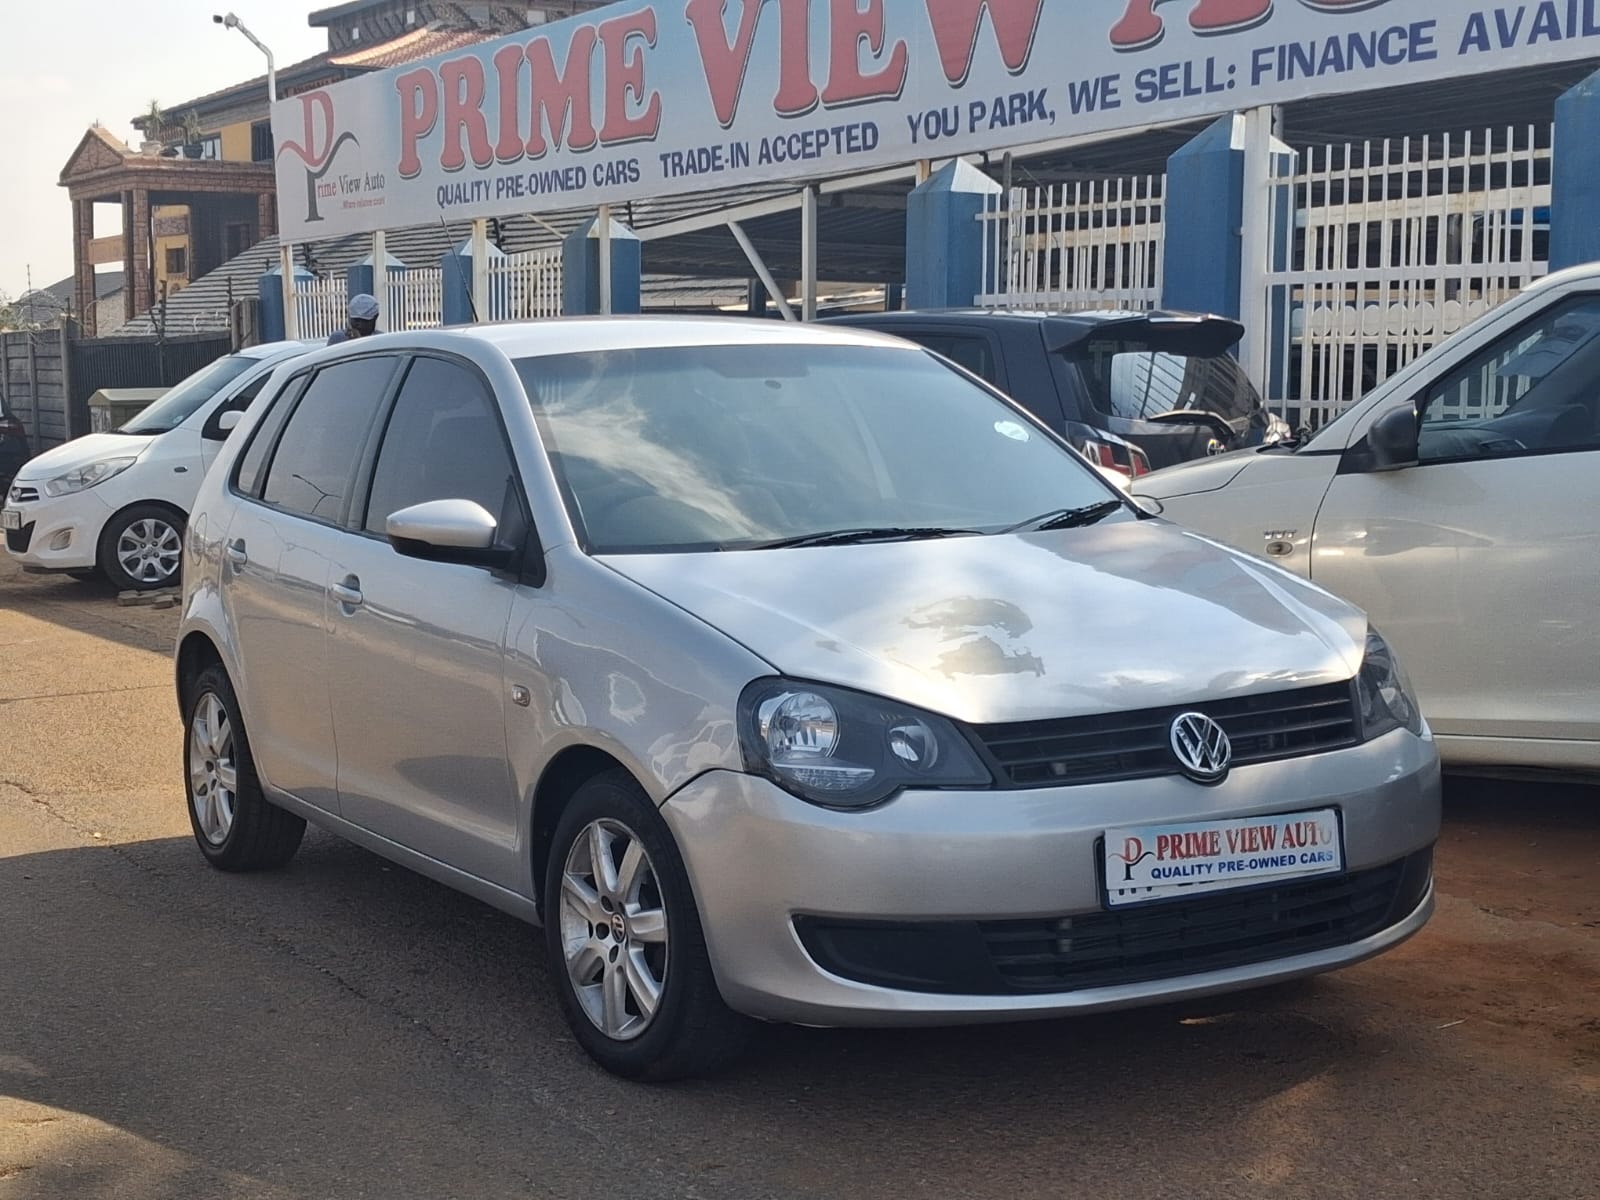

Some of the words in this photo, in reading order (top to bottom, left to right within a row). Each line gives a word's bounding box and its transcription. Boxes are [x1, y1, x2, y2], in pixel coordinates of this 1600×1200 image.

[394, 6, 661, 180] PRIME
[685, 0, 1043, 129] VIEW
[907, 106, 960, 144] YOU
[969, 88, 1056, 133] PARK,
[1068, 73, 1121, 114] WE
[1134, 57, 1237, 103] SELL:
[1251, 19, 1438, 86] FINANCE
[659, 142, 750, 178] TRADE-IN
[758, 121, 879, 165] ACCEPTED
[339, 174, 361, 195] View
[364, 171, 385, 192] Auto
[436, 178, 491, 208] QUALITY
[496, 166, 587, 200] PRE-OWNED
[592, 158, 641, 187] CARS
[1150, 863, 1213, 879] QUALITY
[1218, 855, 1297, 873] PRE-OWNED
[1300, 850, 1334, 865] CARS
[1156, 830, 1221, 861] PRIME
[1225, 824, 1278, 853] VIEW
